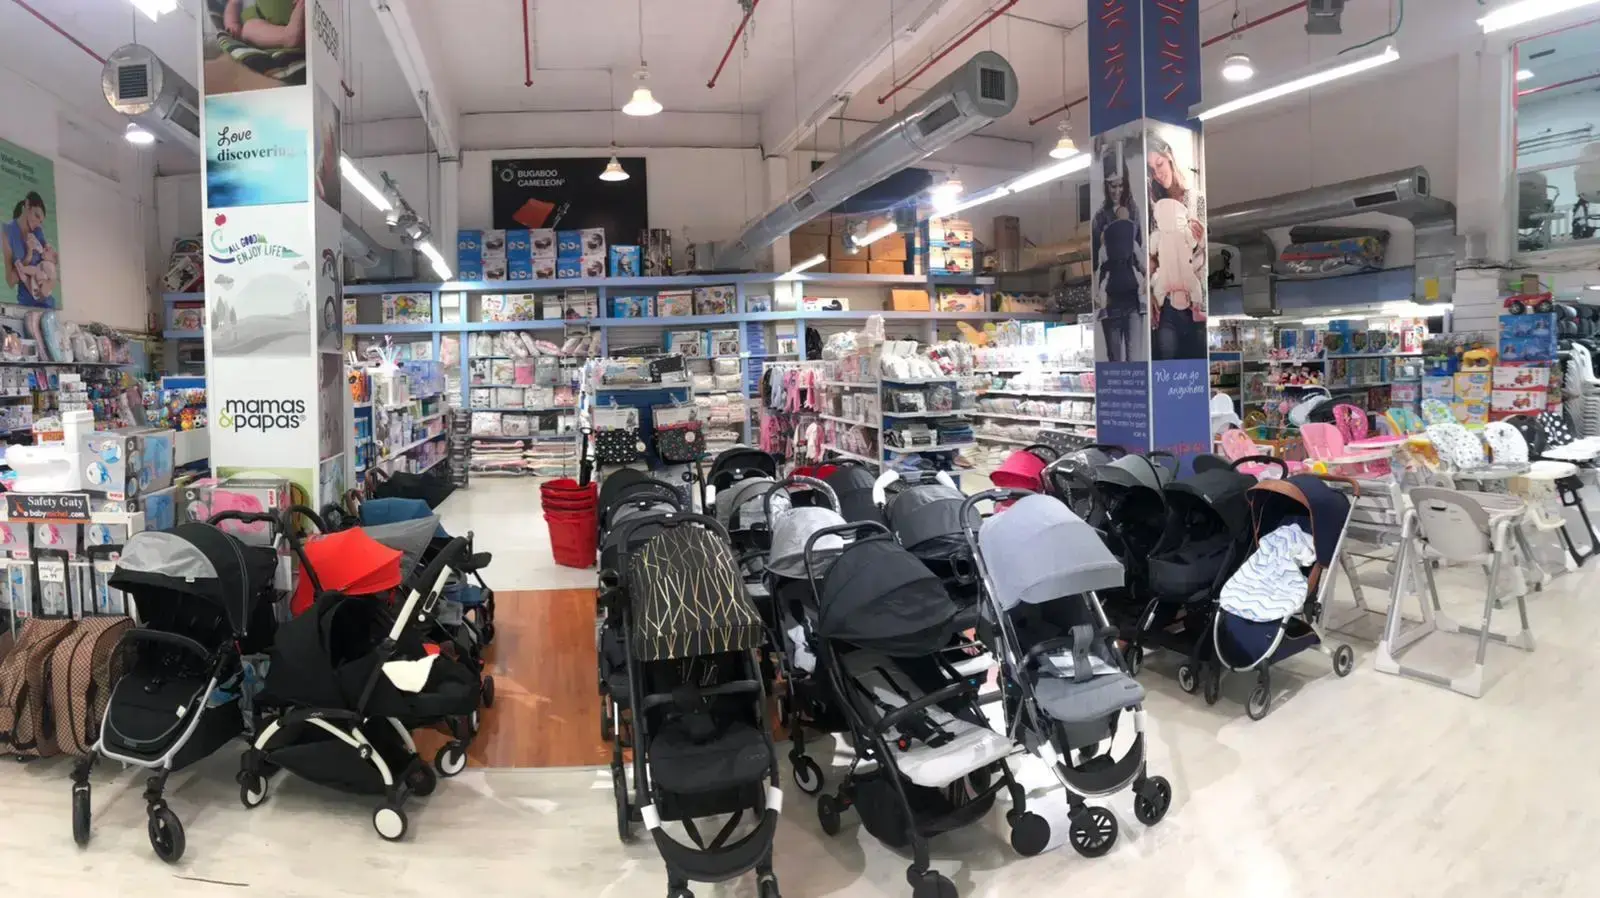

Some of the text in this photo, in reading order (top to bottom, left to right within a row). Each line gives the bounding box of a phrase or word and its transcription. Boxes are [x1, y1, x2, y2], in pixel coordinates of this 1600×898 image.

[217, 125, 252, 146] Love
[217, 144, 295, 162] discovering
[517, 169, 558, 177] BUGABOO
[228, 242, 240, 254] ALL
[236, 245, 283, 265] ENJOY LIFE
[1154, 367, 1169, 382] We
[1172, 371, 1187, 380] can
[1189, 370, 1199, 385] go
[1167, 384, 1204, 399] anywhere
[226, 399, 305, 413] mamas
[27, 496, 84, 509] Safety Gaty
